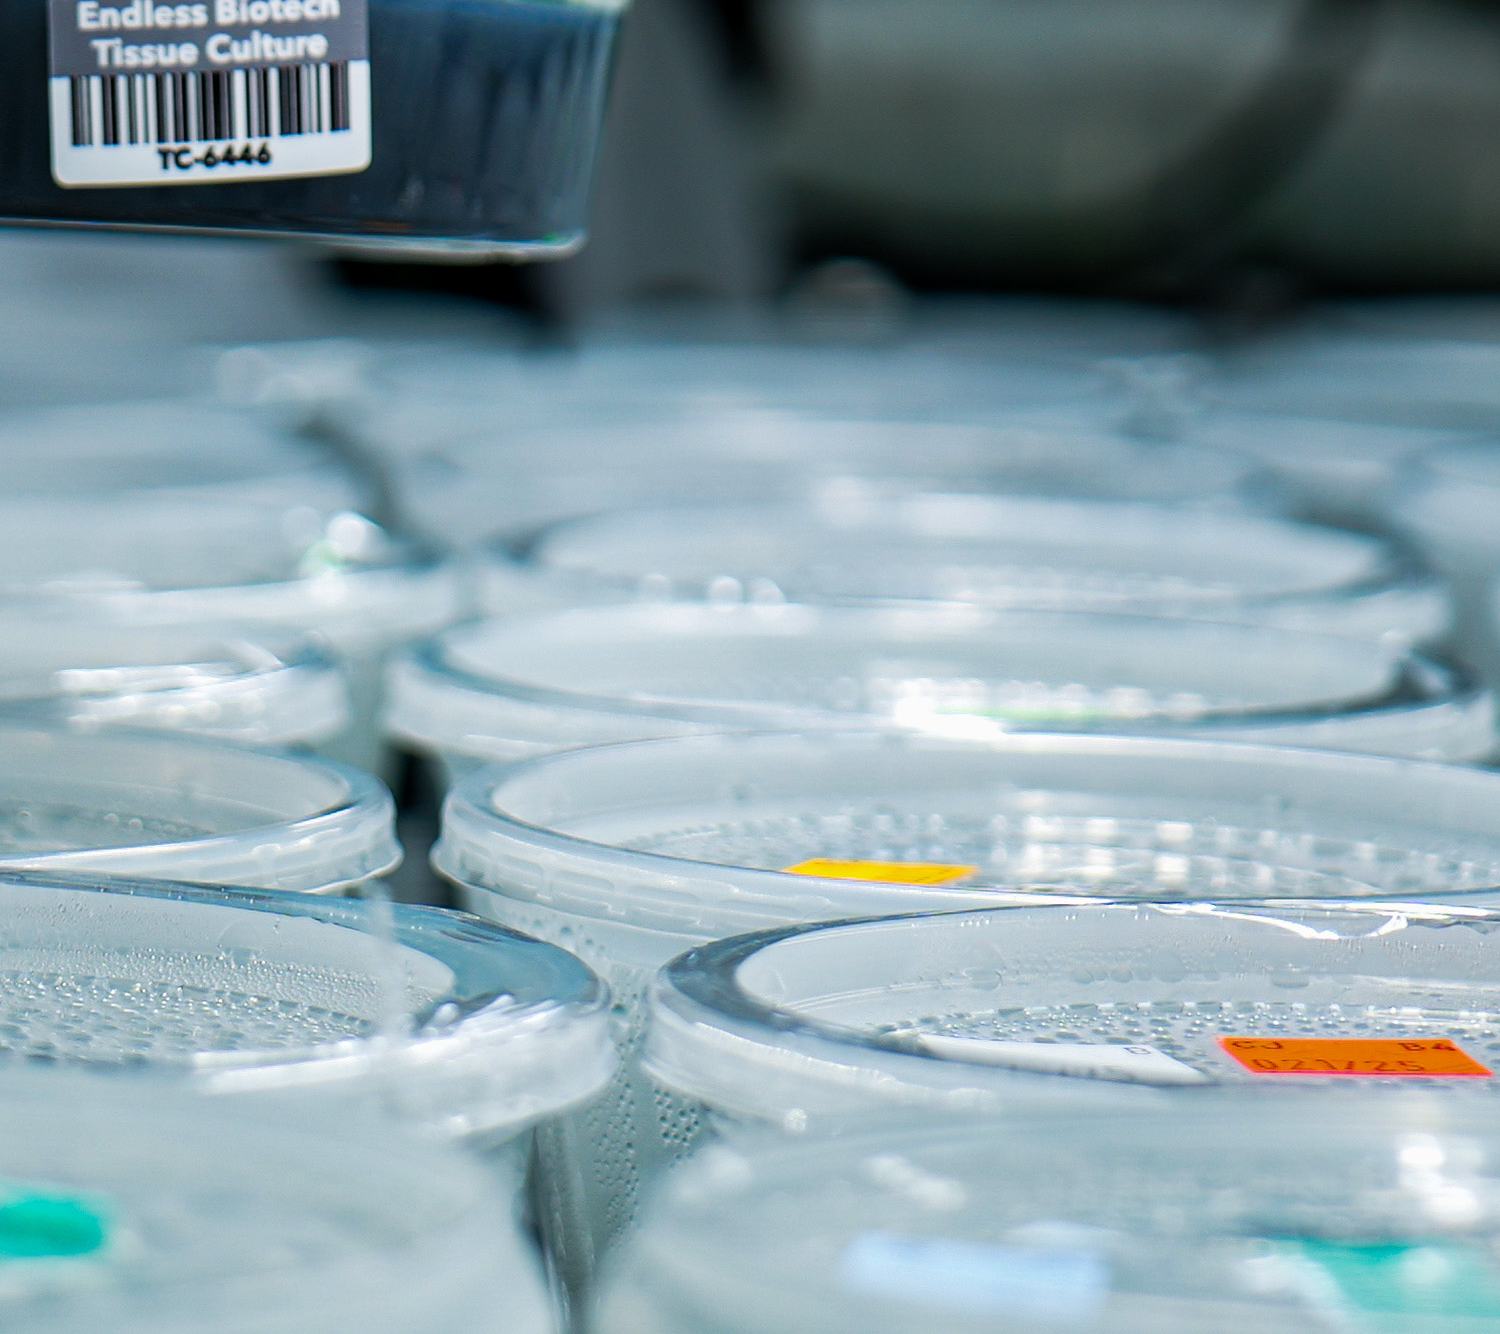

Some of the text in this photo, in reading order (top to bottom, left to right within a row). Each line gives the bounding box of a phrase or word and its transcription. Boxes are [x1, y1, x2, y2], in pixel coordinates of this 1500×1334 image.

[91, 30, 328, 66] Tissue Culture
[157, 142, 272, 169] TC-6446
